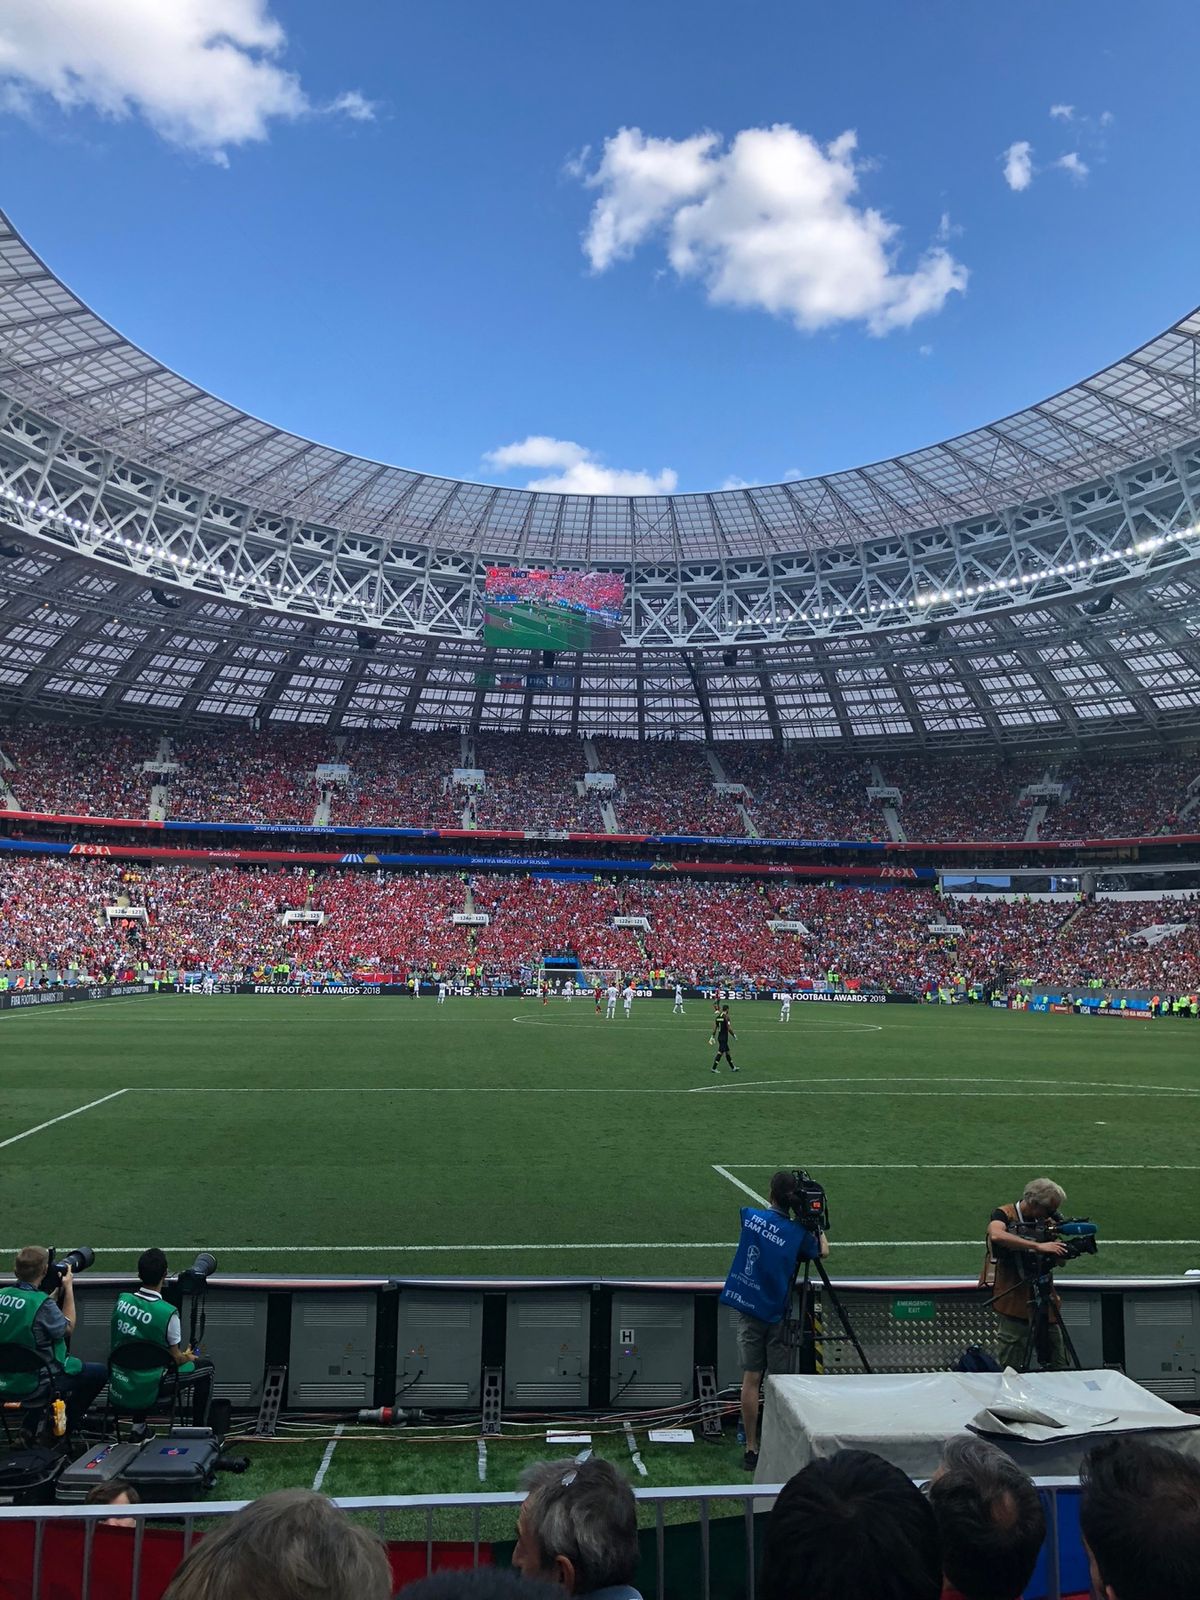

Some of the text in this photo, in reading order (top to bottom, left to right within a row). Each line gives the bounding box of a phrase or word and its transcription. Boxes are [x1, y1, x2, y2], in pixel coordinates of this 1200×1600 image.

[203, 984, 240, 994] EST
[254, 986, 380, 994] FIFA FOOTALL AWARDS 2018
[446, 986, 506, 996] THE EST
[701, 990, 760, 1000] THE BEST
[792, 992, 832, 1002] FOOTBALL
[834, 994, 868, 1002] AWARDS
[870, 994, 887, 1003] 2018
[1080, 1006, 1090, 1014] VISA
[751, 1214, 780, 1234] FIFA TV
[744, 1219, 786, 1248] EAM CREW
[0, 1294, 26, 1310] HOTO
[116, 1300, 152, 1324] PHOTO
[117, 1319, 138, 1336] 984
[622, 1330, 632, 1342] H
